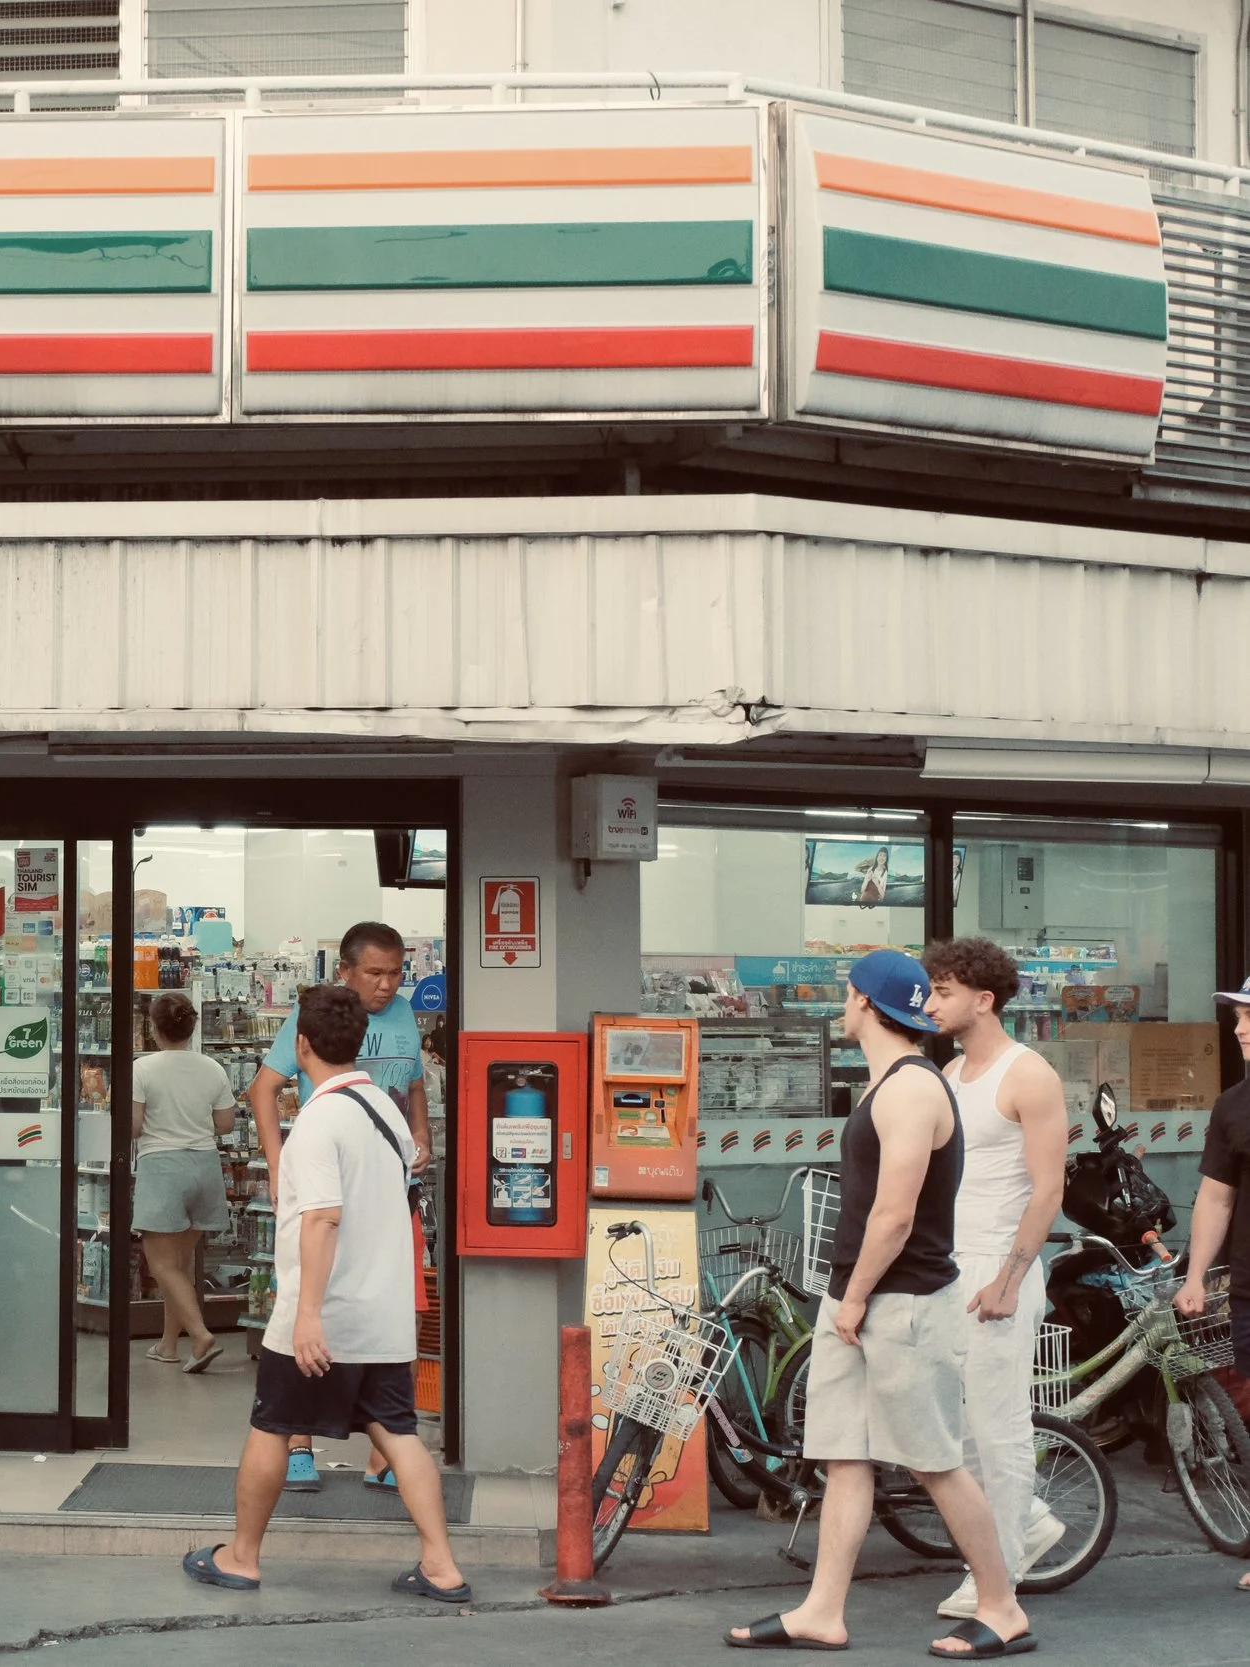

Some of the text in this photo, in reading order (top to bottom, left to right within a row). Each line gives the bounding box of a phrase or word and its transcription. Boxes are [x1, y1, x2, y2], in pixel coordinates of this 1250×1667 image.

[17, 873, 56, 882] TOURIST
[17, 882, 38, 892] SIM
[909, 984, 923, 1008] LA
[9, 1039, 43, 1048] Green
